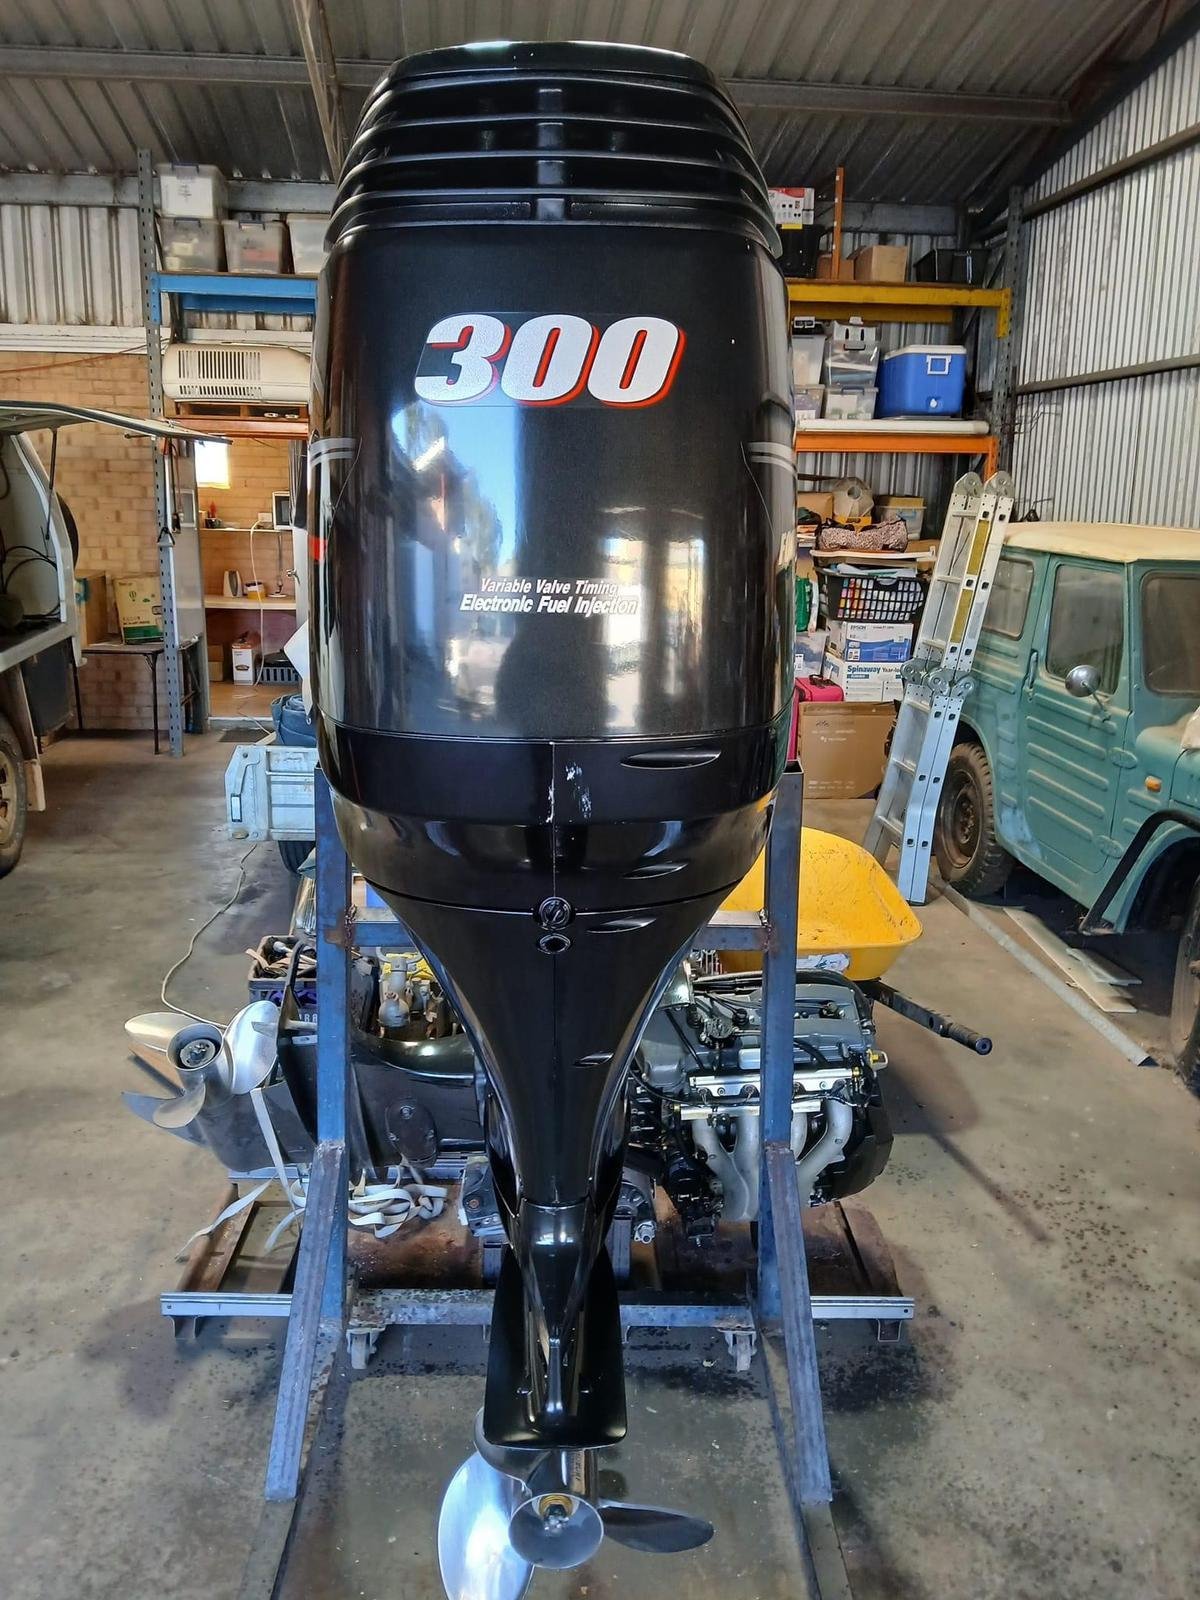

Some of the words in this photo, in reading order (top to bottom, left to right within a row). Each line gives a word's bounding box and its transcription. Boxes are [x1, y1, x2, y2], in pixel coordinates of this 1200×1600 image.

[414, 314, 686, 407] 300
[480, 578, 532, 593] Variable
[536, 579, 570, 594] Valve
[575, 580, 619, 597] Timing
[460, 594, 533, 612] Electronic
[537, 596, 573, 613] Fuel
[574, 596, 638, 618] Injection
[847, 665, 880, 674] Spinaway
